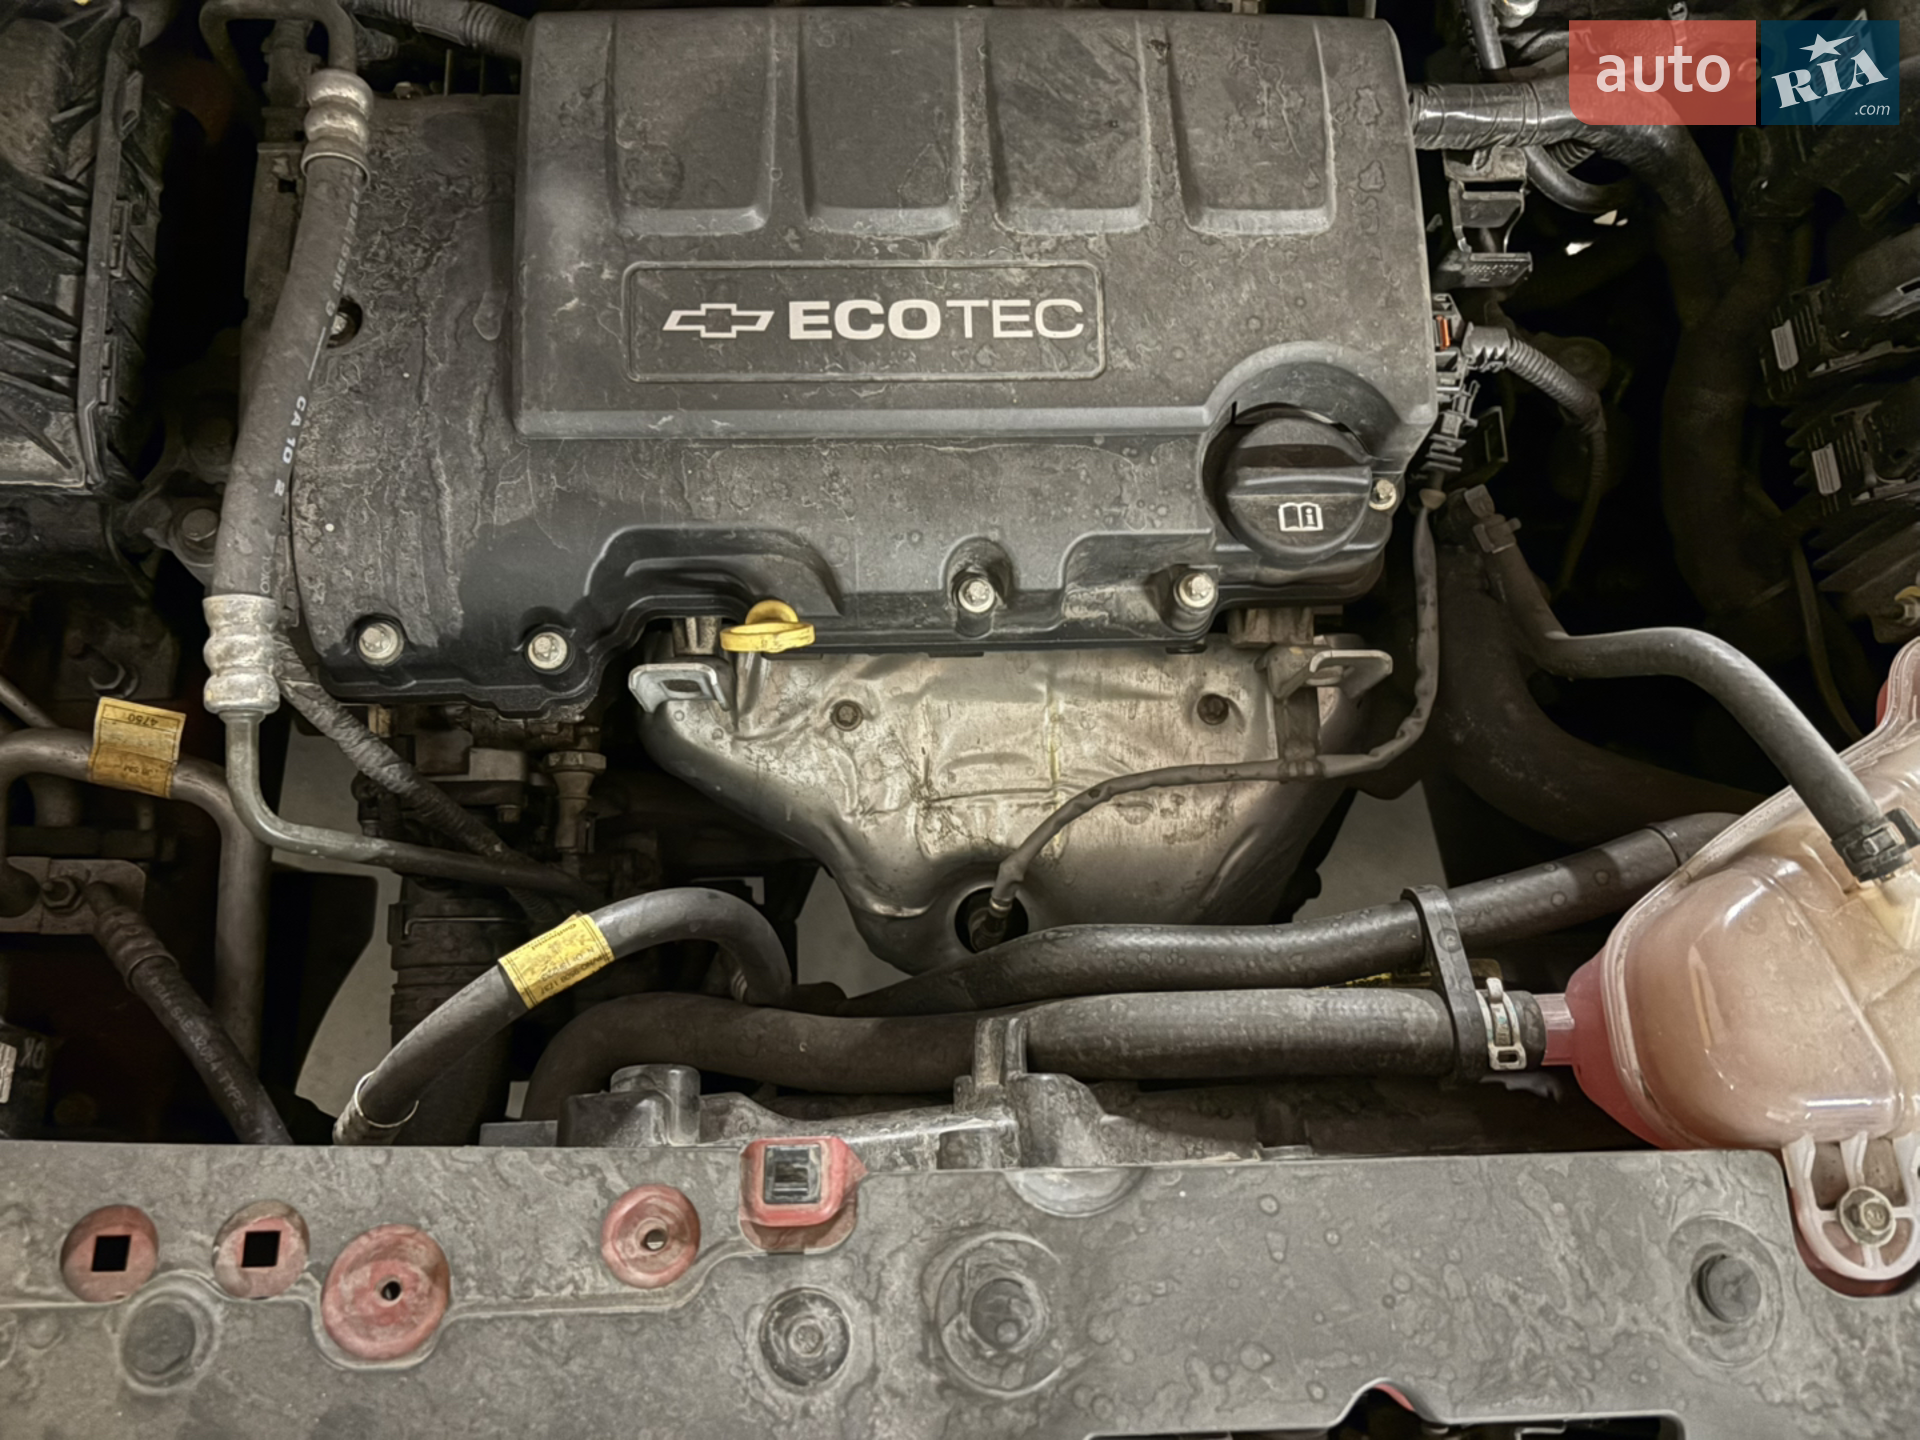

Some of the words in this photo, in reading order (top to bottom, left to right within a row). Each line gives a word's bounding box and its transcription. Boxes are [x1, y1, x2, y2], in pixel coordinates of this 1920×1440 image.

[788, 299, 1085, 340] ECOTEC
[282, 437, 296, 464] 10
[127, 712, 158, 727] 4750
[214, 1070, 248, 1112] TYPE
